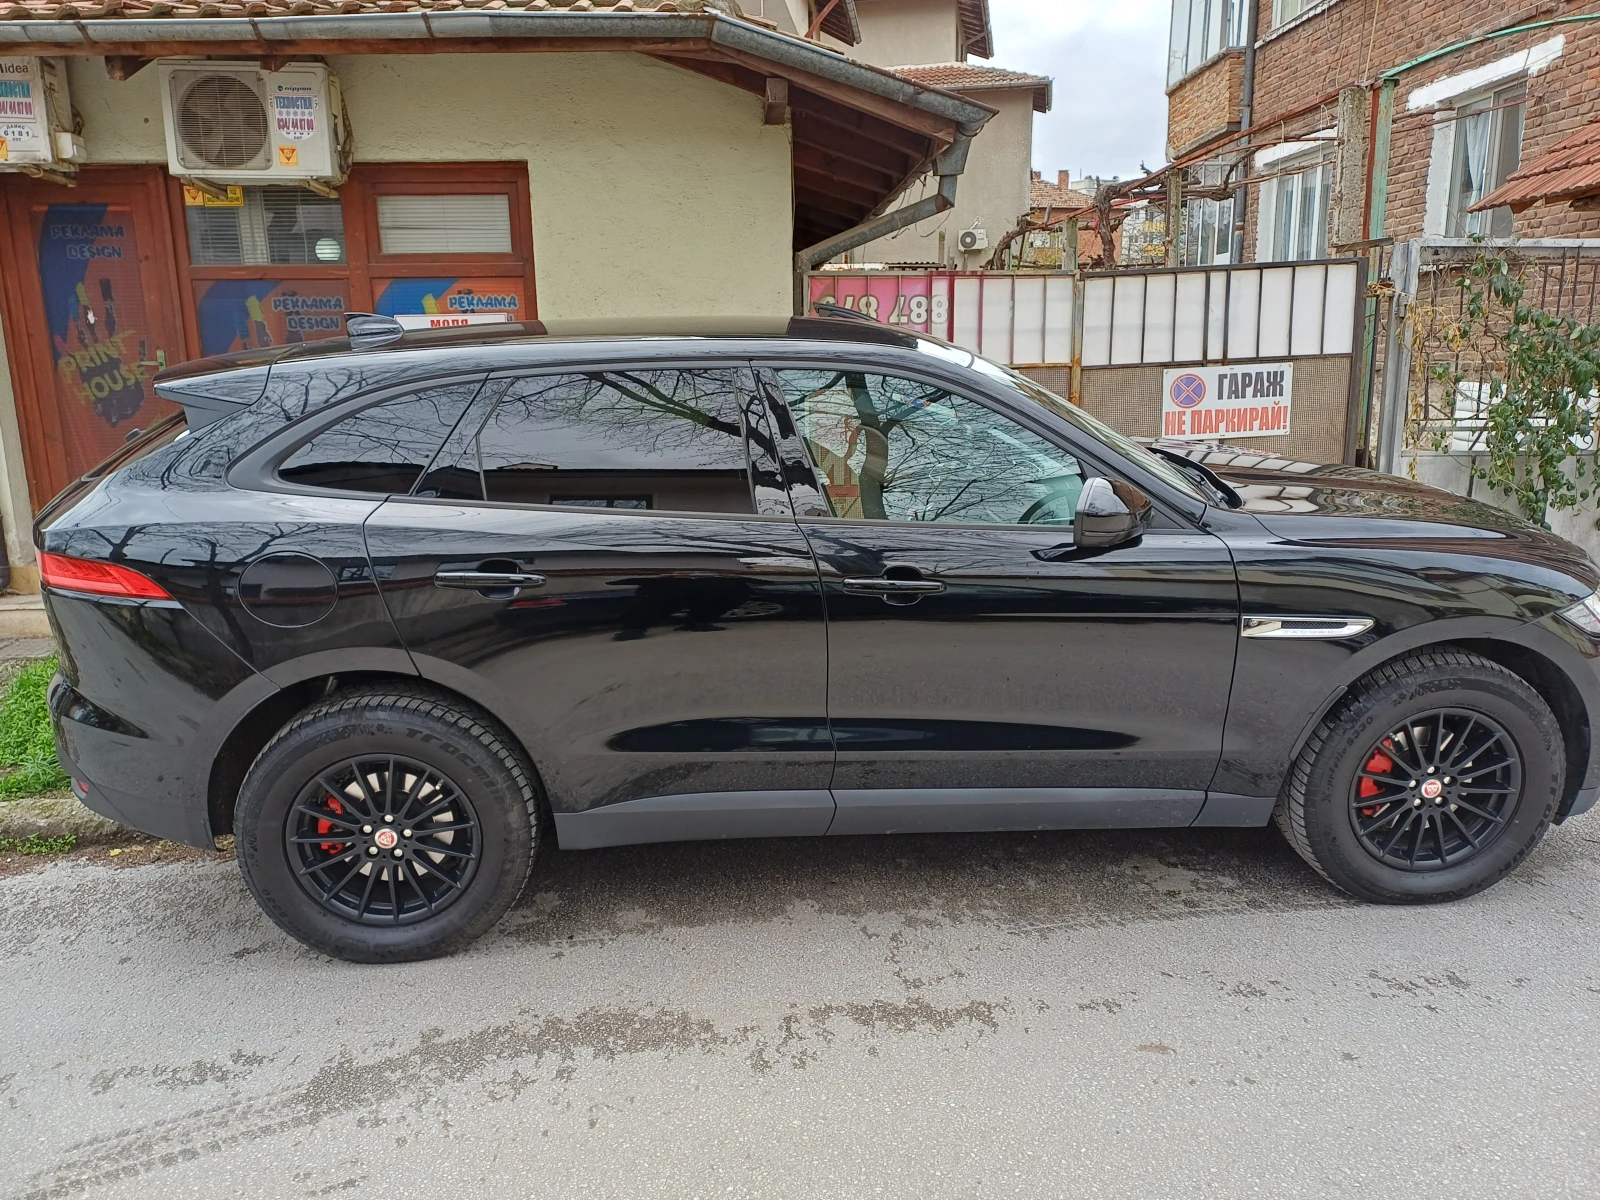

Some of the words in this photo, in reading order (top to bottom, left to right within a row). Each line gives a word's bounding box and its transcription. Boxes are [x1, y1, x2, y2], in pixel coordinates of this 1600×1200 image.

[51, 224, 126, 240] РЕКЛАМА
[67, 244, 124, 259] DESIGN
[272, 296, 344, 312] РЕКЛАМА
[447, 294, 519, 310] РЕКЛАМА
[287, 315, 341, 331] DESIGN
[58, 329, 137, 384] PRINT
[76, 361, 150, 405] HOUSE
[1217, 370, 1285, 400] ГАРАЖ
[1164, 410, 1187, 436] НЕ
[1190, 400, 1289, 435] ПАРКИРАЙ!
